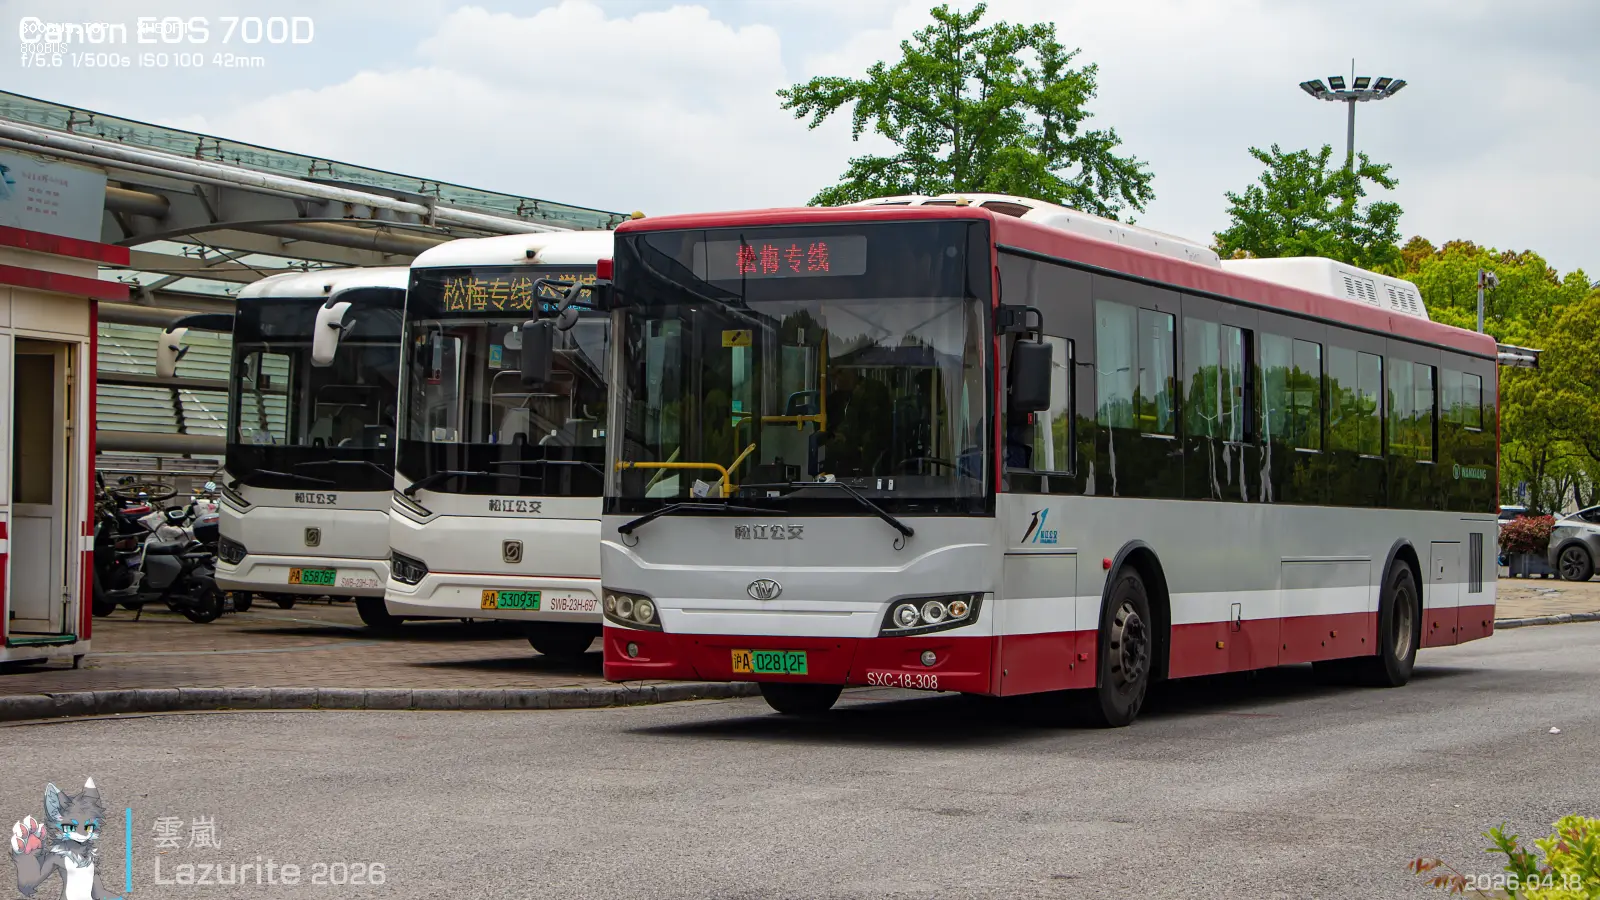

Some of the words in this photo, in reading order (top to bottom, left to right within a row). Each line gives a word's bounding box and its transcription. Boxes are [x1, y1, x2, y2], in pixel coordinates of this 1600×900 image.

[736, 242, 829, 275] 松梅专线
[443, 276, 533, 312] 松梅专线
[294, 492, 337, 505] 松江公交
[488, 499, 542, 513] 松江公交
[734, 524, 804, 540] 松江公交
[550, 598, 598, 611] SWB-23H-697
[867, 672, 938, 689] SXC-18-308
